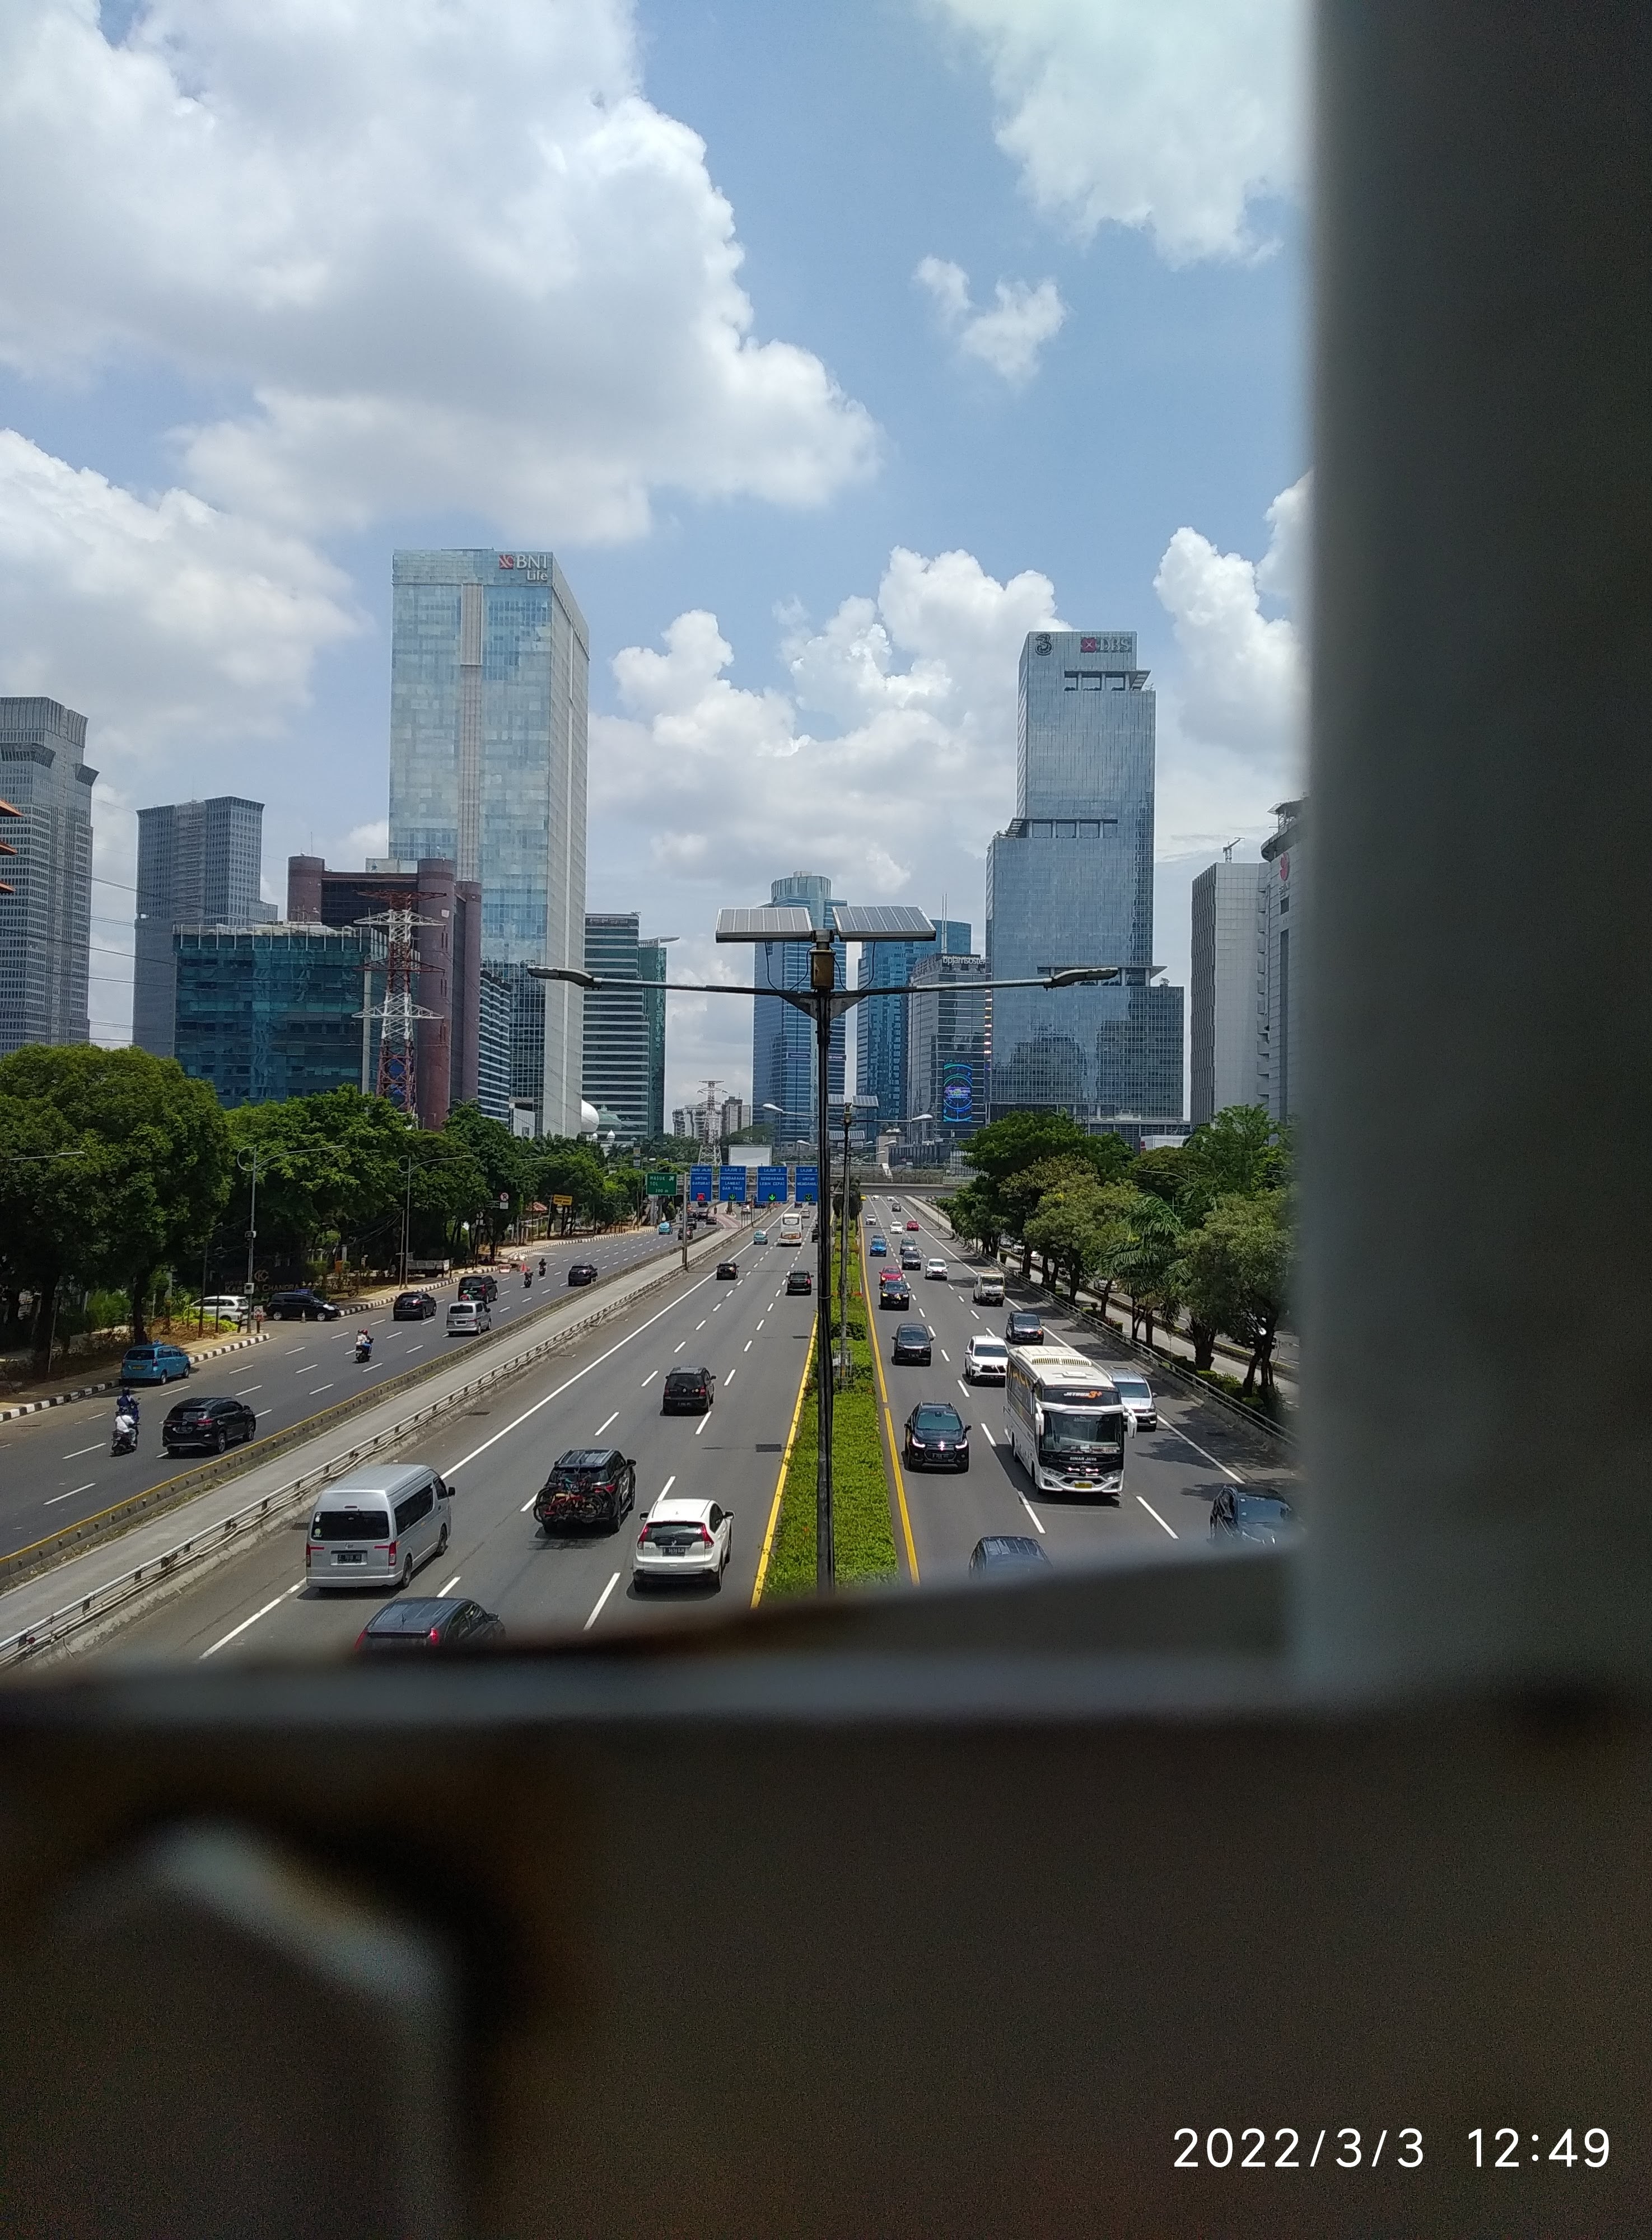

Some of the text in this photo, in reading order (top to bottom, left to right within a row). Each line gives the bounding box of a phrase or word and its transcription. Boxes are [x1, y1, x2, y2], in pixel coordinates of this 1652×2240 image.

[516, 554, 548, 569] BNI
[527, 570, 548, 581] Life
[1099, 638, 1130, 652] DBS
